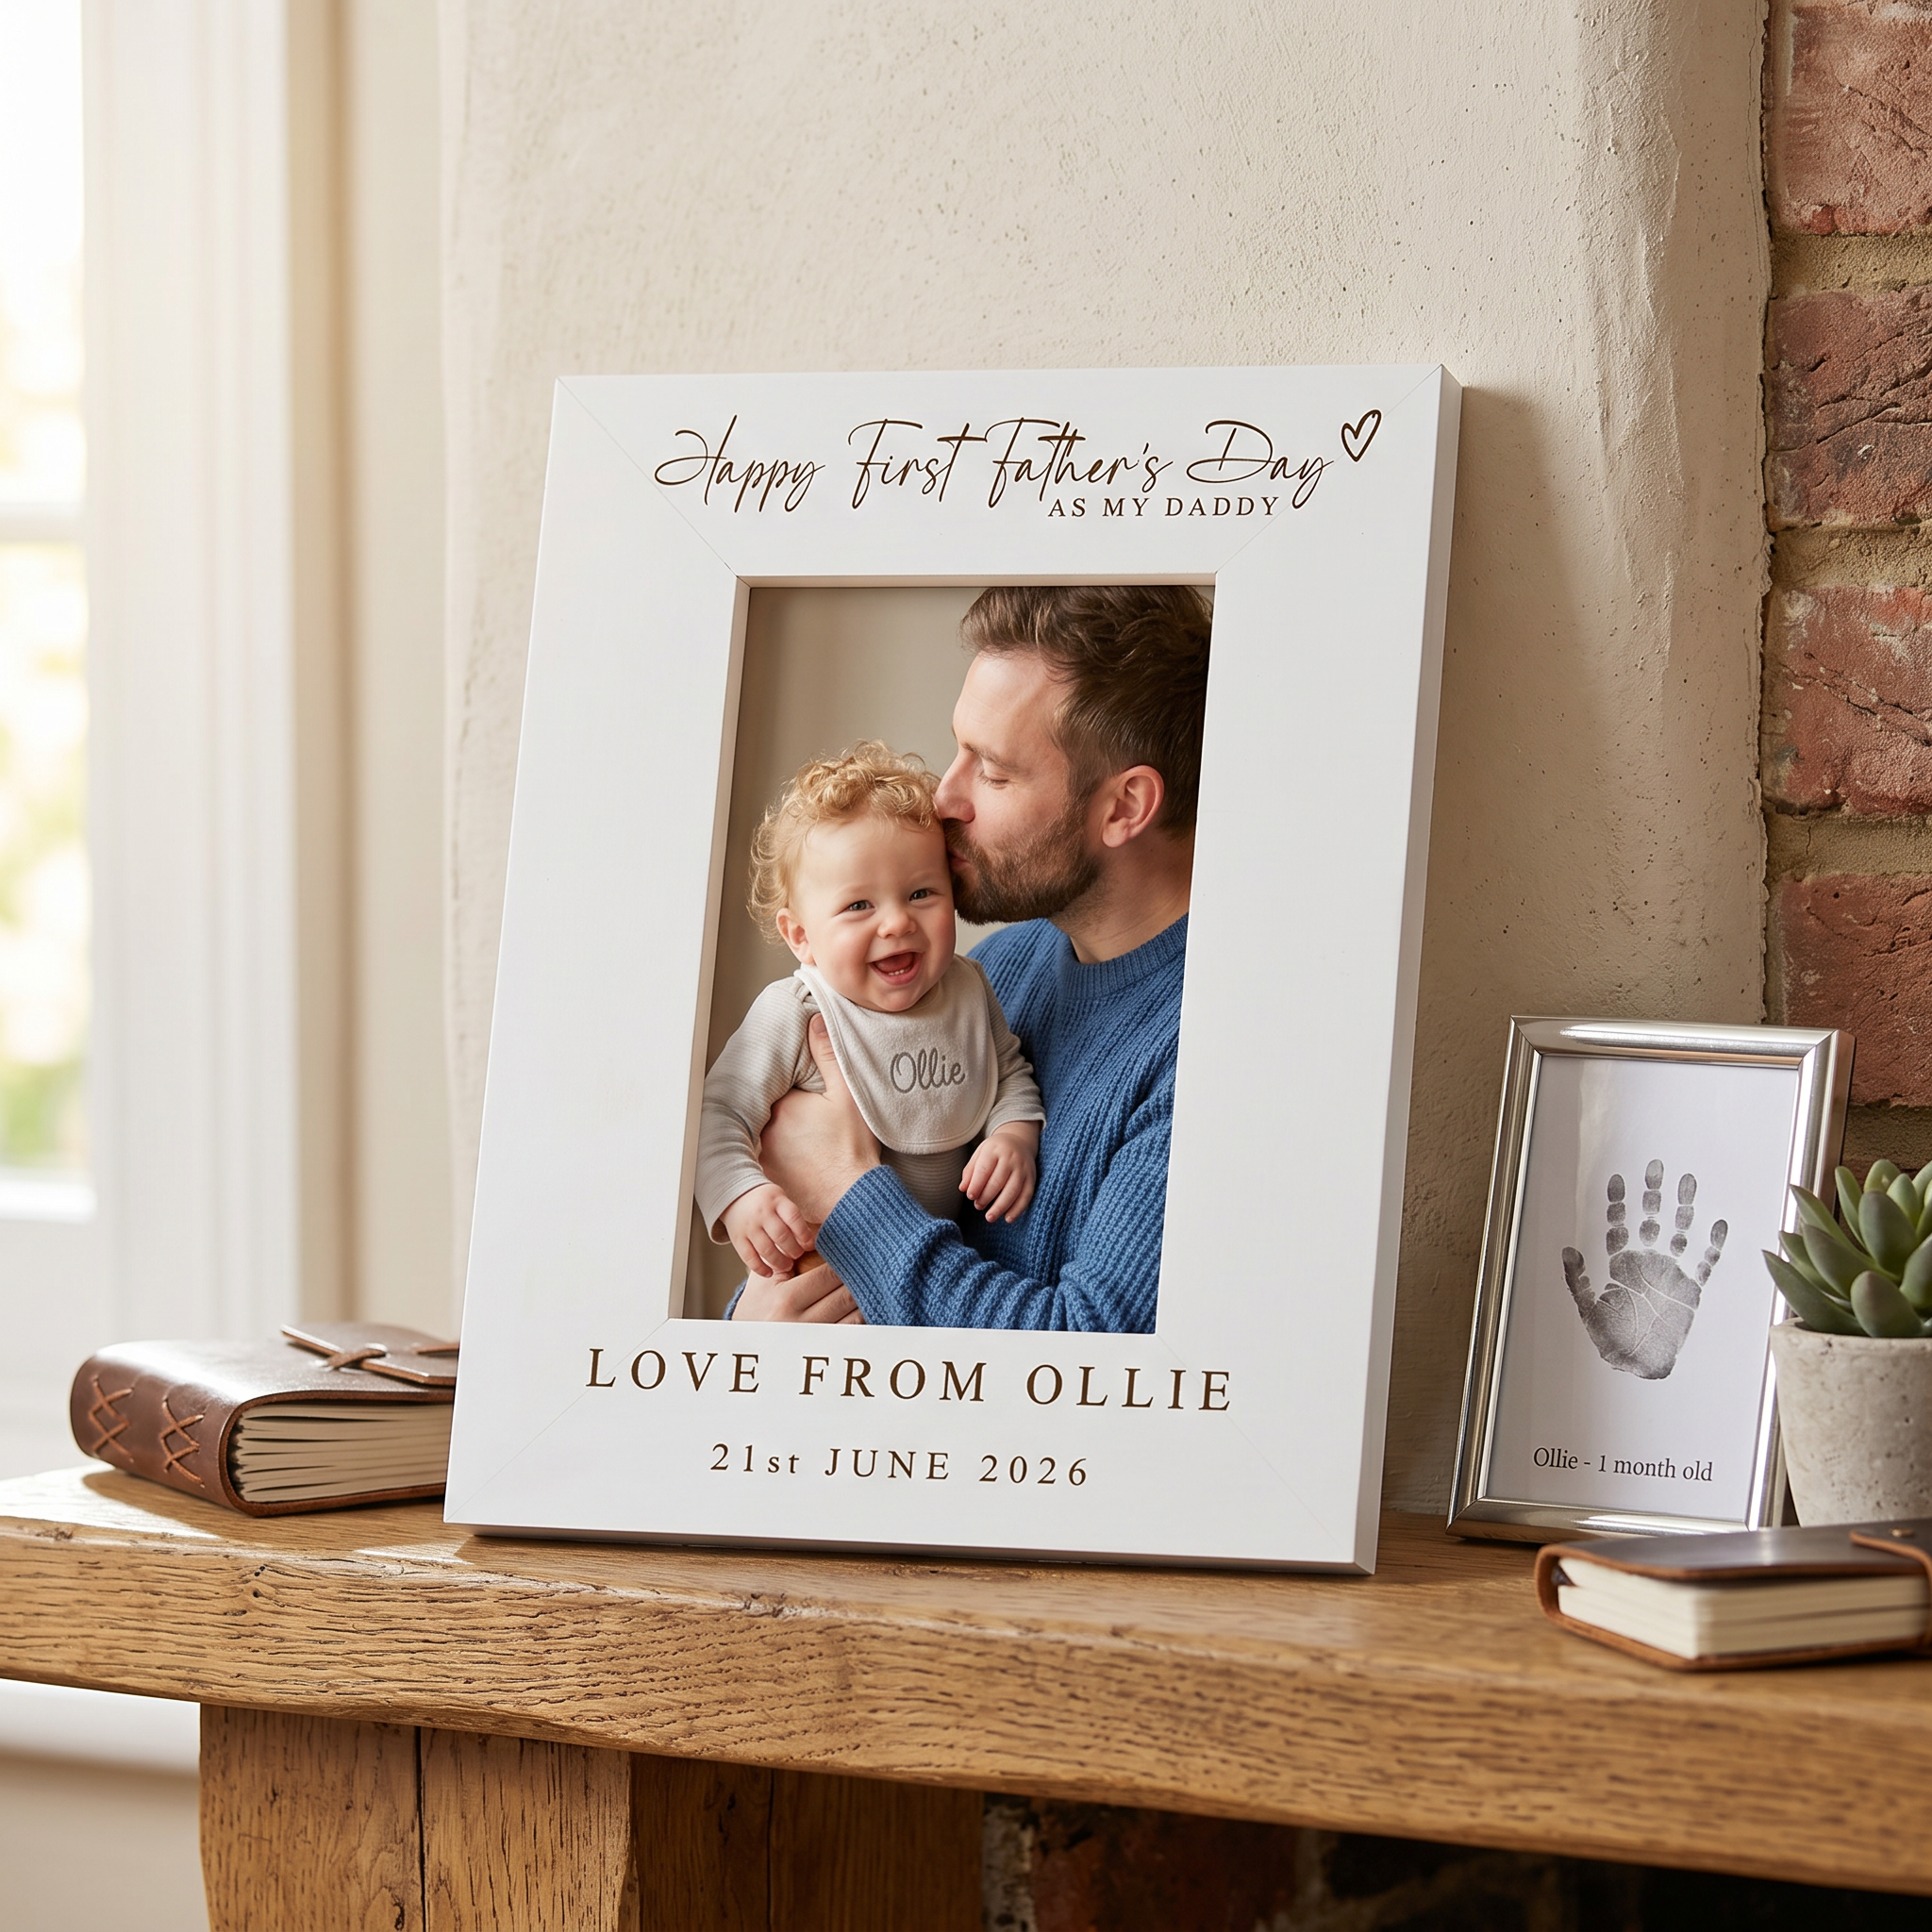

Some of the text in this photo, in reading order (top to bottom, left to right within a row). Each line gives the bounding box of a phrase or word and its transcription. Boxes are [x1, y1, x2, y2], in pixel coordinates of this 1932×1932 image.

[654, 414, 1335, 514] Happy First Father's Day
[1047, 496, 1280, 518] AS MY DADDY
[890, 1047, 966, 1094] Ollie
[585, 1347, 1231, 1411] LOVE FROM OLLIE
[709, 1442, 1088, 1487] 21st JUNE 2026
[1533, 1447, 1579, 1470] Ollie
[1597, 1454, 1607, 1473] 1
[1612, 1457, 1676, 1478] month
[1682, 1460, 1713, 1481] old
